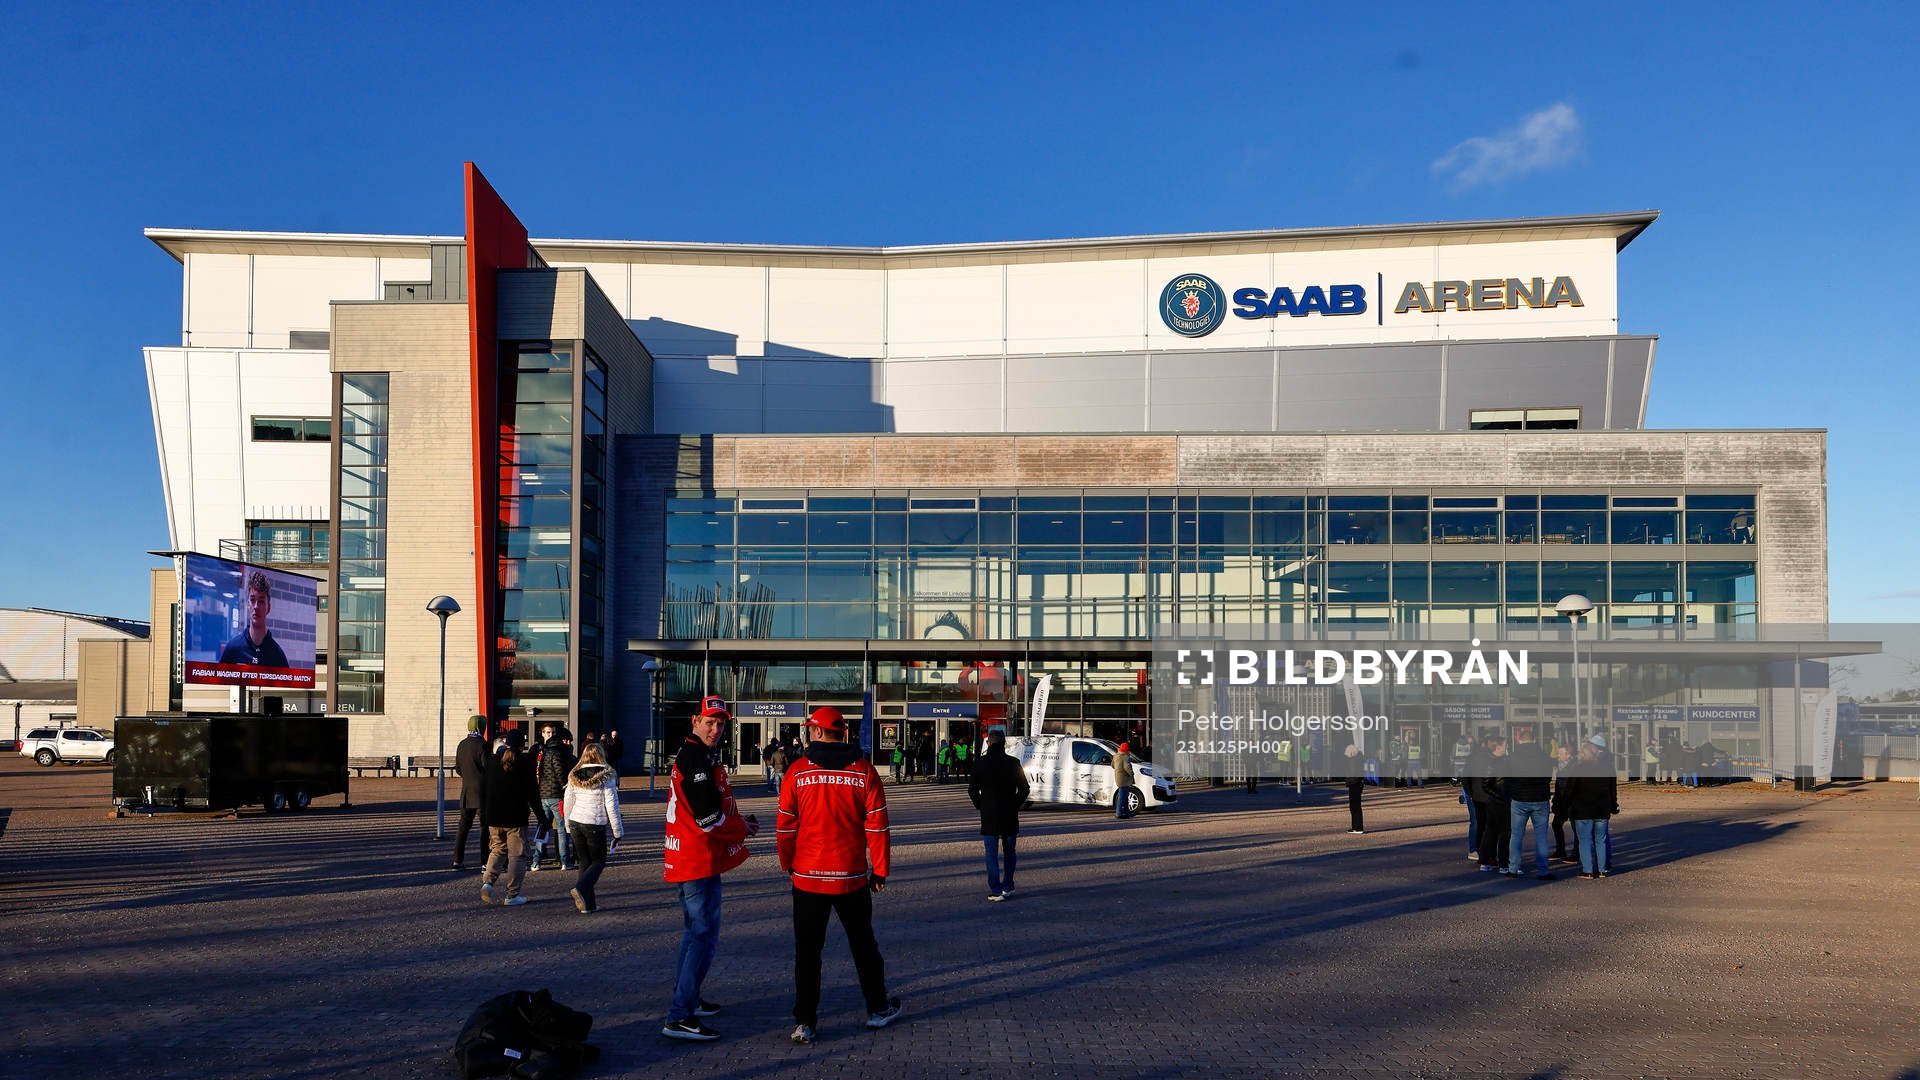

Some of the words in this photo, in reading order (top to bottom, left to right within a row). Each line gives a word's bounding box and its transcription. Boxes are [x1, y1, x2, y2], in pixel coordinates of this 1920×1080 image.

[1176, 279, 1207, 291] SAAB
[1232, 284, 1367, 320] SAAB
[1394, 275, 1585, 314] ARENA
[1173, 314, 1210, 330] TECHNOLOGIES
[192, 668, 215, 677] FABIAN
[216, 670, 241, 679] WAGNER
[242, 672, 258, 680] EFTER
[259, 673, 293, 682] TORSDAGENS
[293, 675, 311, 683] MATCH
[1692, 710, 1756, 719] KUNDCENTER
[796, 775, 865, 788] MALMBERGS
